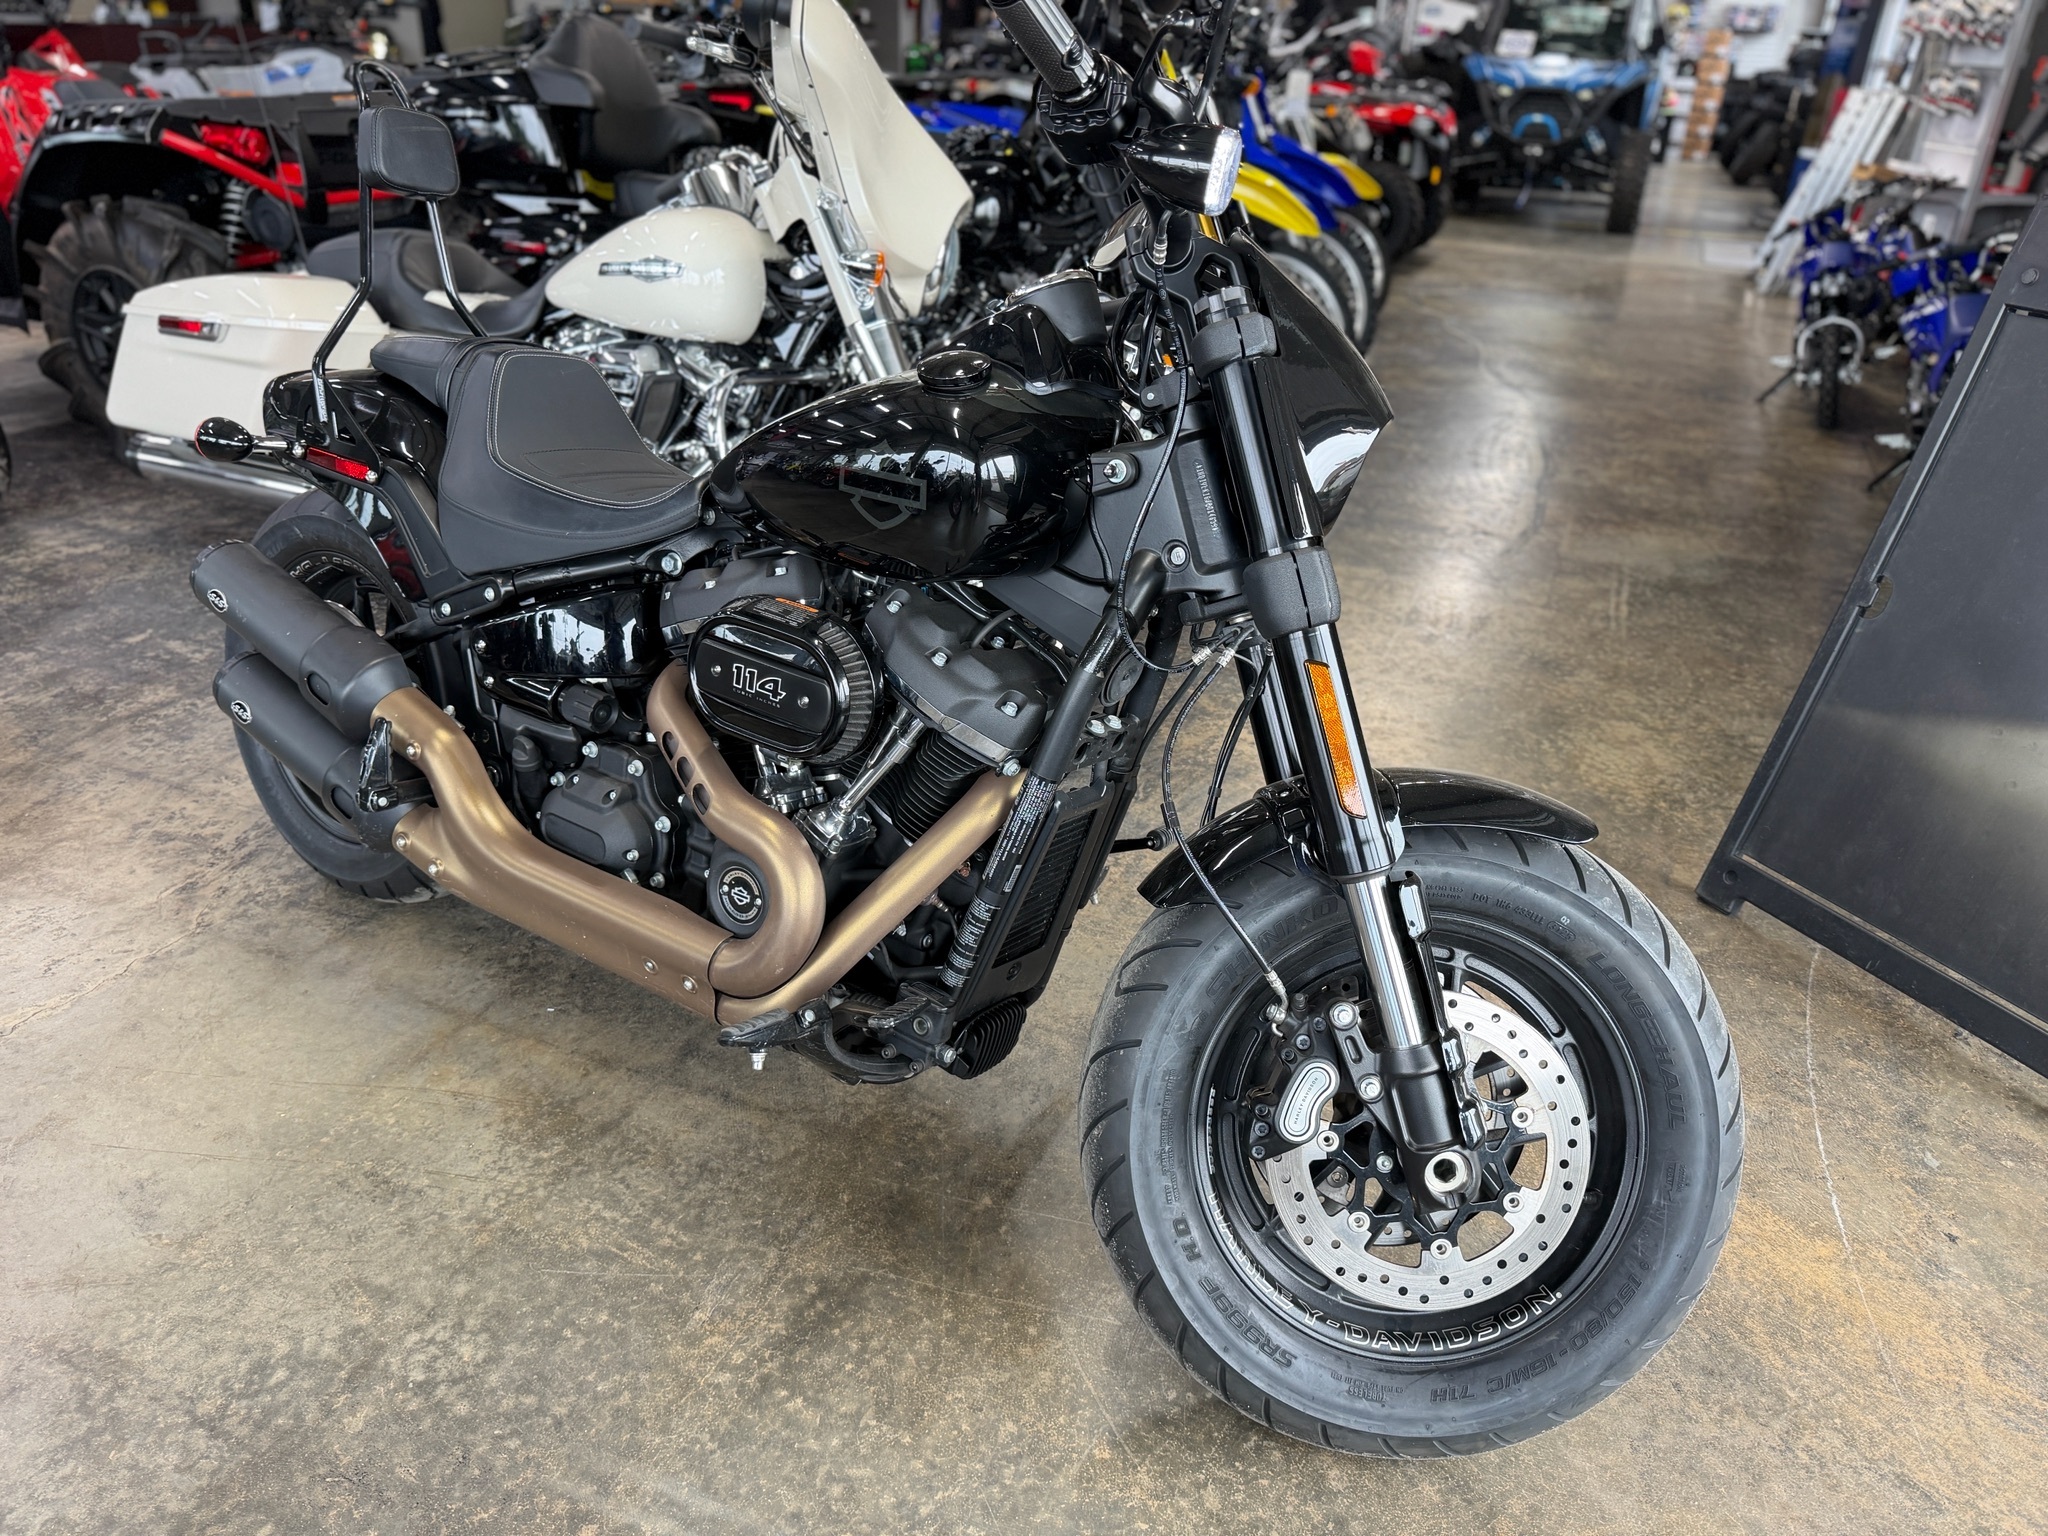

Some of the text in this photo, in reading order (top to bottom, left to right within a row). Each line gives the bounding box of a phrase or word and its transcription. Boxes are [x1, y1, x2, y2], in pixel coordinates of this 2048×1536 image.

[732, 688, 781, 708] CUBIC INCHES
[733, 663, 787, 702] 114
[1472, 892, 1492, 904] DOT
[1206, 895, 1338, 998] SHNKO
[1587, 952, 1687, 1130] LONG HAUL
[1294, 1077, 1318, 1124] HARLEY DAVIDSON
[1199, 1275, 1298, 1369] SR999F
[1569, 1274, 1644, 1351] 150/80
[1348, 1386, 1386, 1402] TUBELESS
[1430, 1384, 1477, 1403] 71H
[1487, 1357, 1558, 1394] 16M/C
